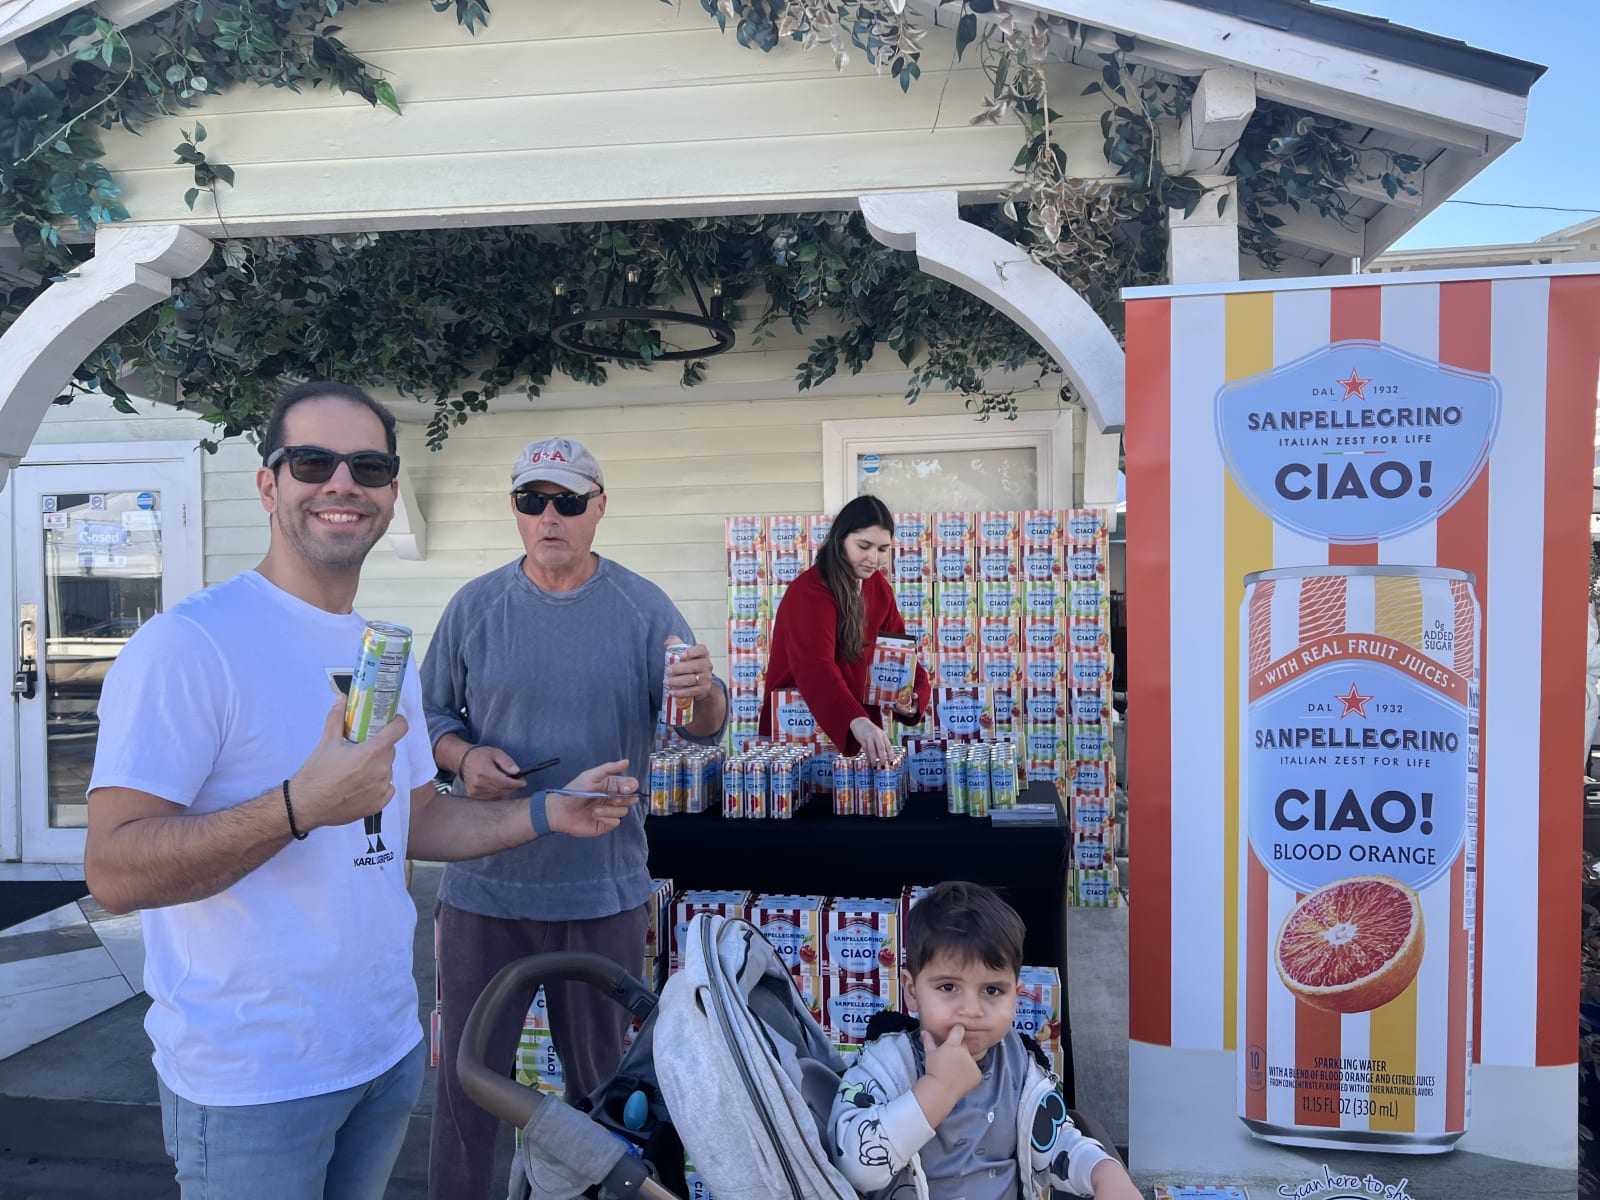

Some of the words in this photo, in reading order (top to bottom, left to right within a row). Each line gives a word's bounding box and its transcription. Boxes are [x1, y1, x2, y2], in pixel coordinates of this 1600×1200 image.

[1312, 388, 1335, 396] DAL
[1373, 385, 1399, 394] 1932
[1248, 406, 1460, 431] SANPELLEGRINO
[1279, 437, 1329, 447] ITALIAN
[1336, 436, 1365, 445] ZEST
[1373, 435, 1398, 444] FOR
[1405, 434, 1432, 444] LIFE
[1274, 460, 1433, 500] CIAO!
[1423, 630, 1454, 641] ADDED
[1424, 640, 1452, 651] SUGAR
[1264, 657, 1300, 685] WITH
[1301, 640, 1343, 666] REAL
[1348, 639, 1399, 660] FRUIT
[1399, 653, 1449, 688] JUICES
[878, 675, 902, 683] CIAO!
[1307, 703, 1333, 712] DAL
[1375, 703, 1403, 713] 1932
[787, 718, 815, 727] CIAO!
[949, 715, 977, 723] CIAO!
[1255, 727, 1459, 753] SANPELLEGRINO
[1279, 756, 1327, 766] ITALIAN
[1335, 756, 1366, 766] ZEST
[1374, 756, 1399, 767] FOR
[1407, 758, 1431, 768] LIFE
[817, 769, 833, 777] CIA
[1274, 788, 1434, 836] CIAO!
[1273, 843, 1342, 861] BLOOD
[1349, 844, 1437, 865] ORANGE
[353, 857, 376, 867] KARL
[776, 945, 798, 955] AO!
[841, 948, 876, 959] CIAO!
[834, 1000, 885, 1009] SANPELLEGRINO
[1012, 1020, 1039, 1031] IAO!
[547, 1045, 556, 1076] CIAO!
[1250, 1051, 1260, 1070] 10
[1314, 1056, 1358, 1071] SPARKLING
[1359, 1059, 1387, 1072] WATER
[1268, 1066, 1283, 1077] WITH
[1283, 1067, 1288, 1078] A
[1288, 1068, 1309, 1079] BLEND
[1310, 1069, 1319, 1080] OF
[1320, 1070, 1343, 1081] BLOOD
[1344, 1071, 1374, 1083] ORANGE
[1375, 1073, 1391, 1084] AND
[1391, 1074, 1415, 1086] CITRUS
[1415, 1076, 1435, 1087] JUICES
[1269, 1078, 1282, 1087] FROM
[1282, 1079, 1318, 1090] CONCENTRATE
[1319, 1082, 1348, 1092] FLAVORED
[1348, 1083, 1364, 1093] WITH
[1365, 1084, 1385, 1094] OTHER
[1385, 1086, 1411, 1096] NATURAL
[1411, 1087, 1434, 1097] FLAVORS
[1302, 1096, 1322, 1113] 11.15
[1324, 1097, 1336, 1114] FL
[1338, 1098, 1351, 1115] OZ
[1353, 1097, 1377, 1119] (330
[1379, 1100, 1399, 1120] mL)
[1278, 1179, 1323, 1200] Scan
[1323, 1165, 1360, 1189] here
[1363, 1175, 1383, 1192] to
[694, 1181, 703, 1200] CIA
